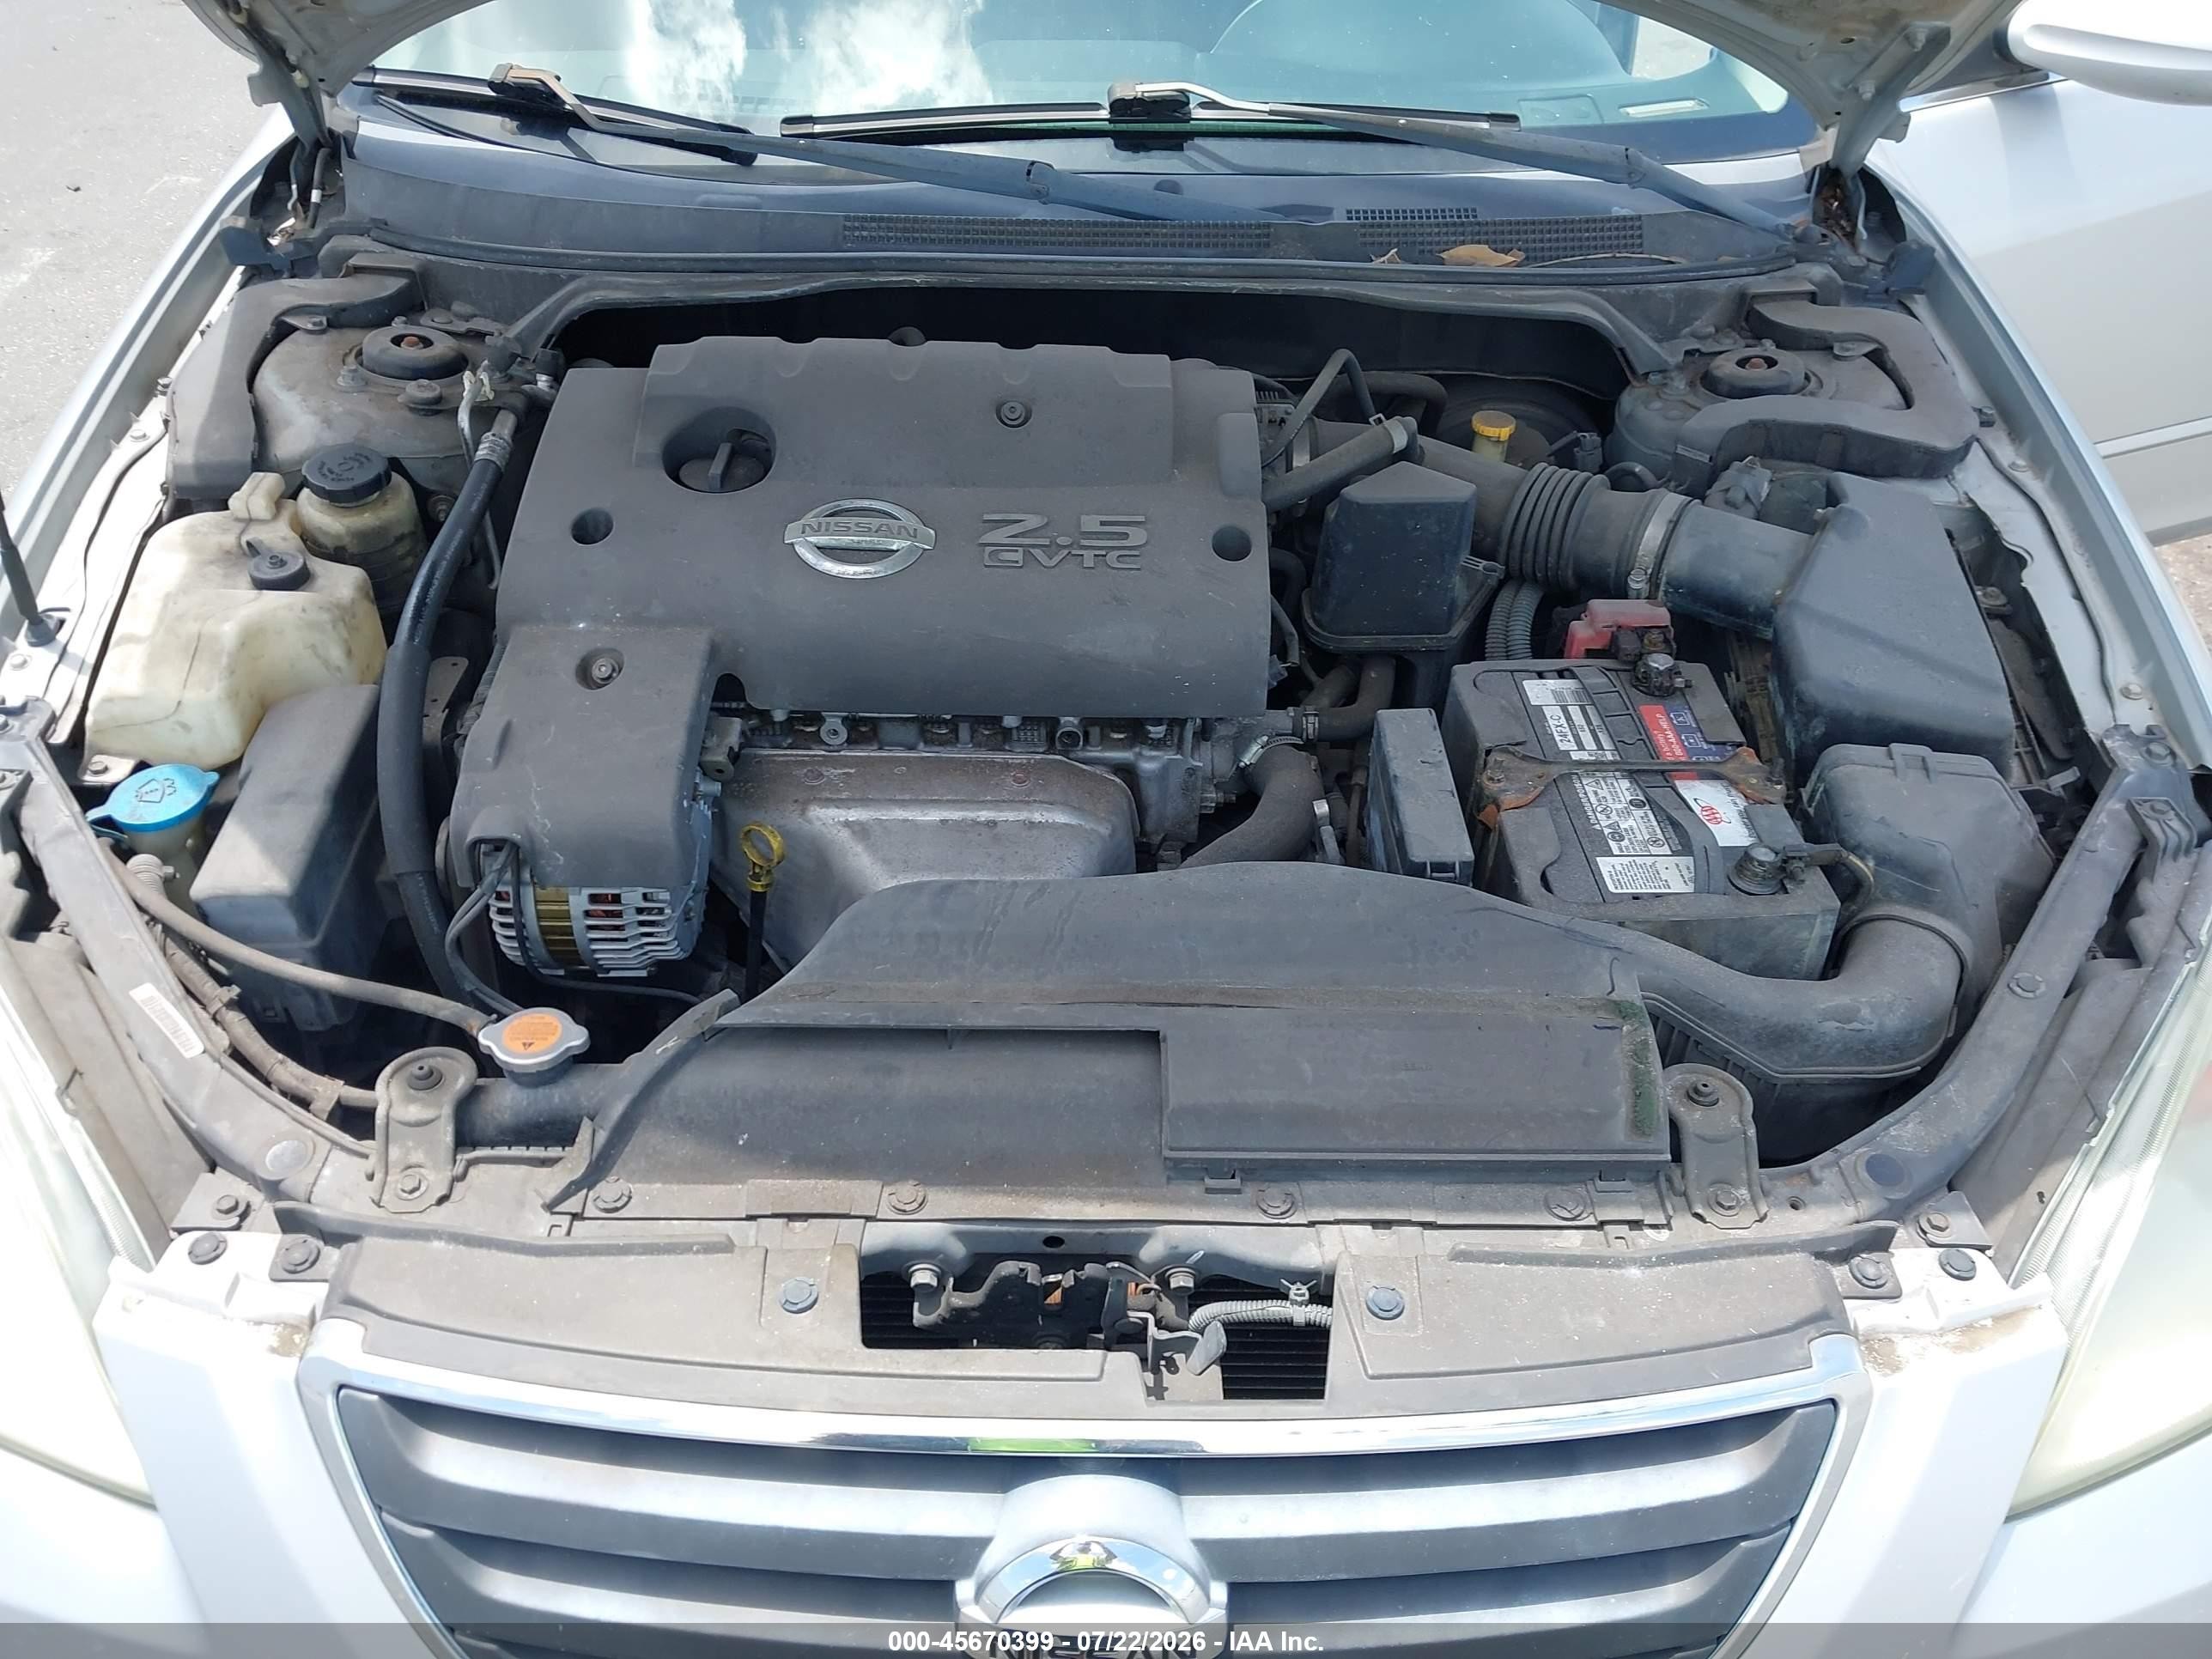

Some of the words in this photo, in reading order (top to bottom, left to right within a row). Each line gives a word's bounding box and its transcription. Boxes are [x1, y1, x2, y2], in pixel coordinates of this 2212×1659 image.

[800, 520, 918, 539] NISSAN
[978, 513, 1148, 547] 2.5
[1549, 714, 1574, 744] 24FX-C
